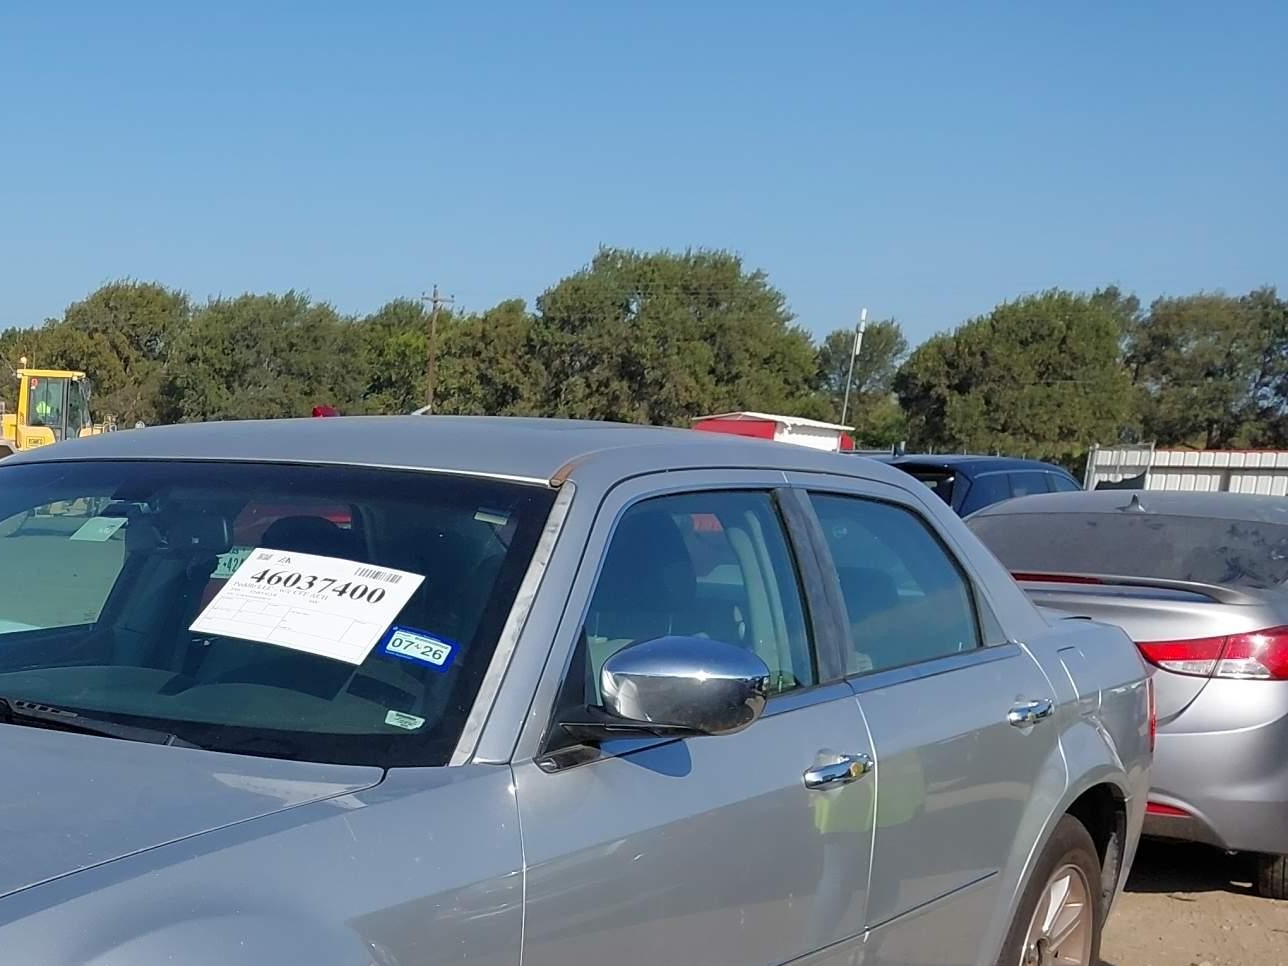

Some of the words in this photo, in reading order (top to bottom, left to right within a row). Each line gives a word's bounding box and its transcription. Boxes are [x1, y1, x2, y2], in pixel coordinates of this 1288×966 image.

[250, 568, 386, 604] 46037400
[391, 637, 415, 650] 07
[420, 645, 444, 660] 26
